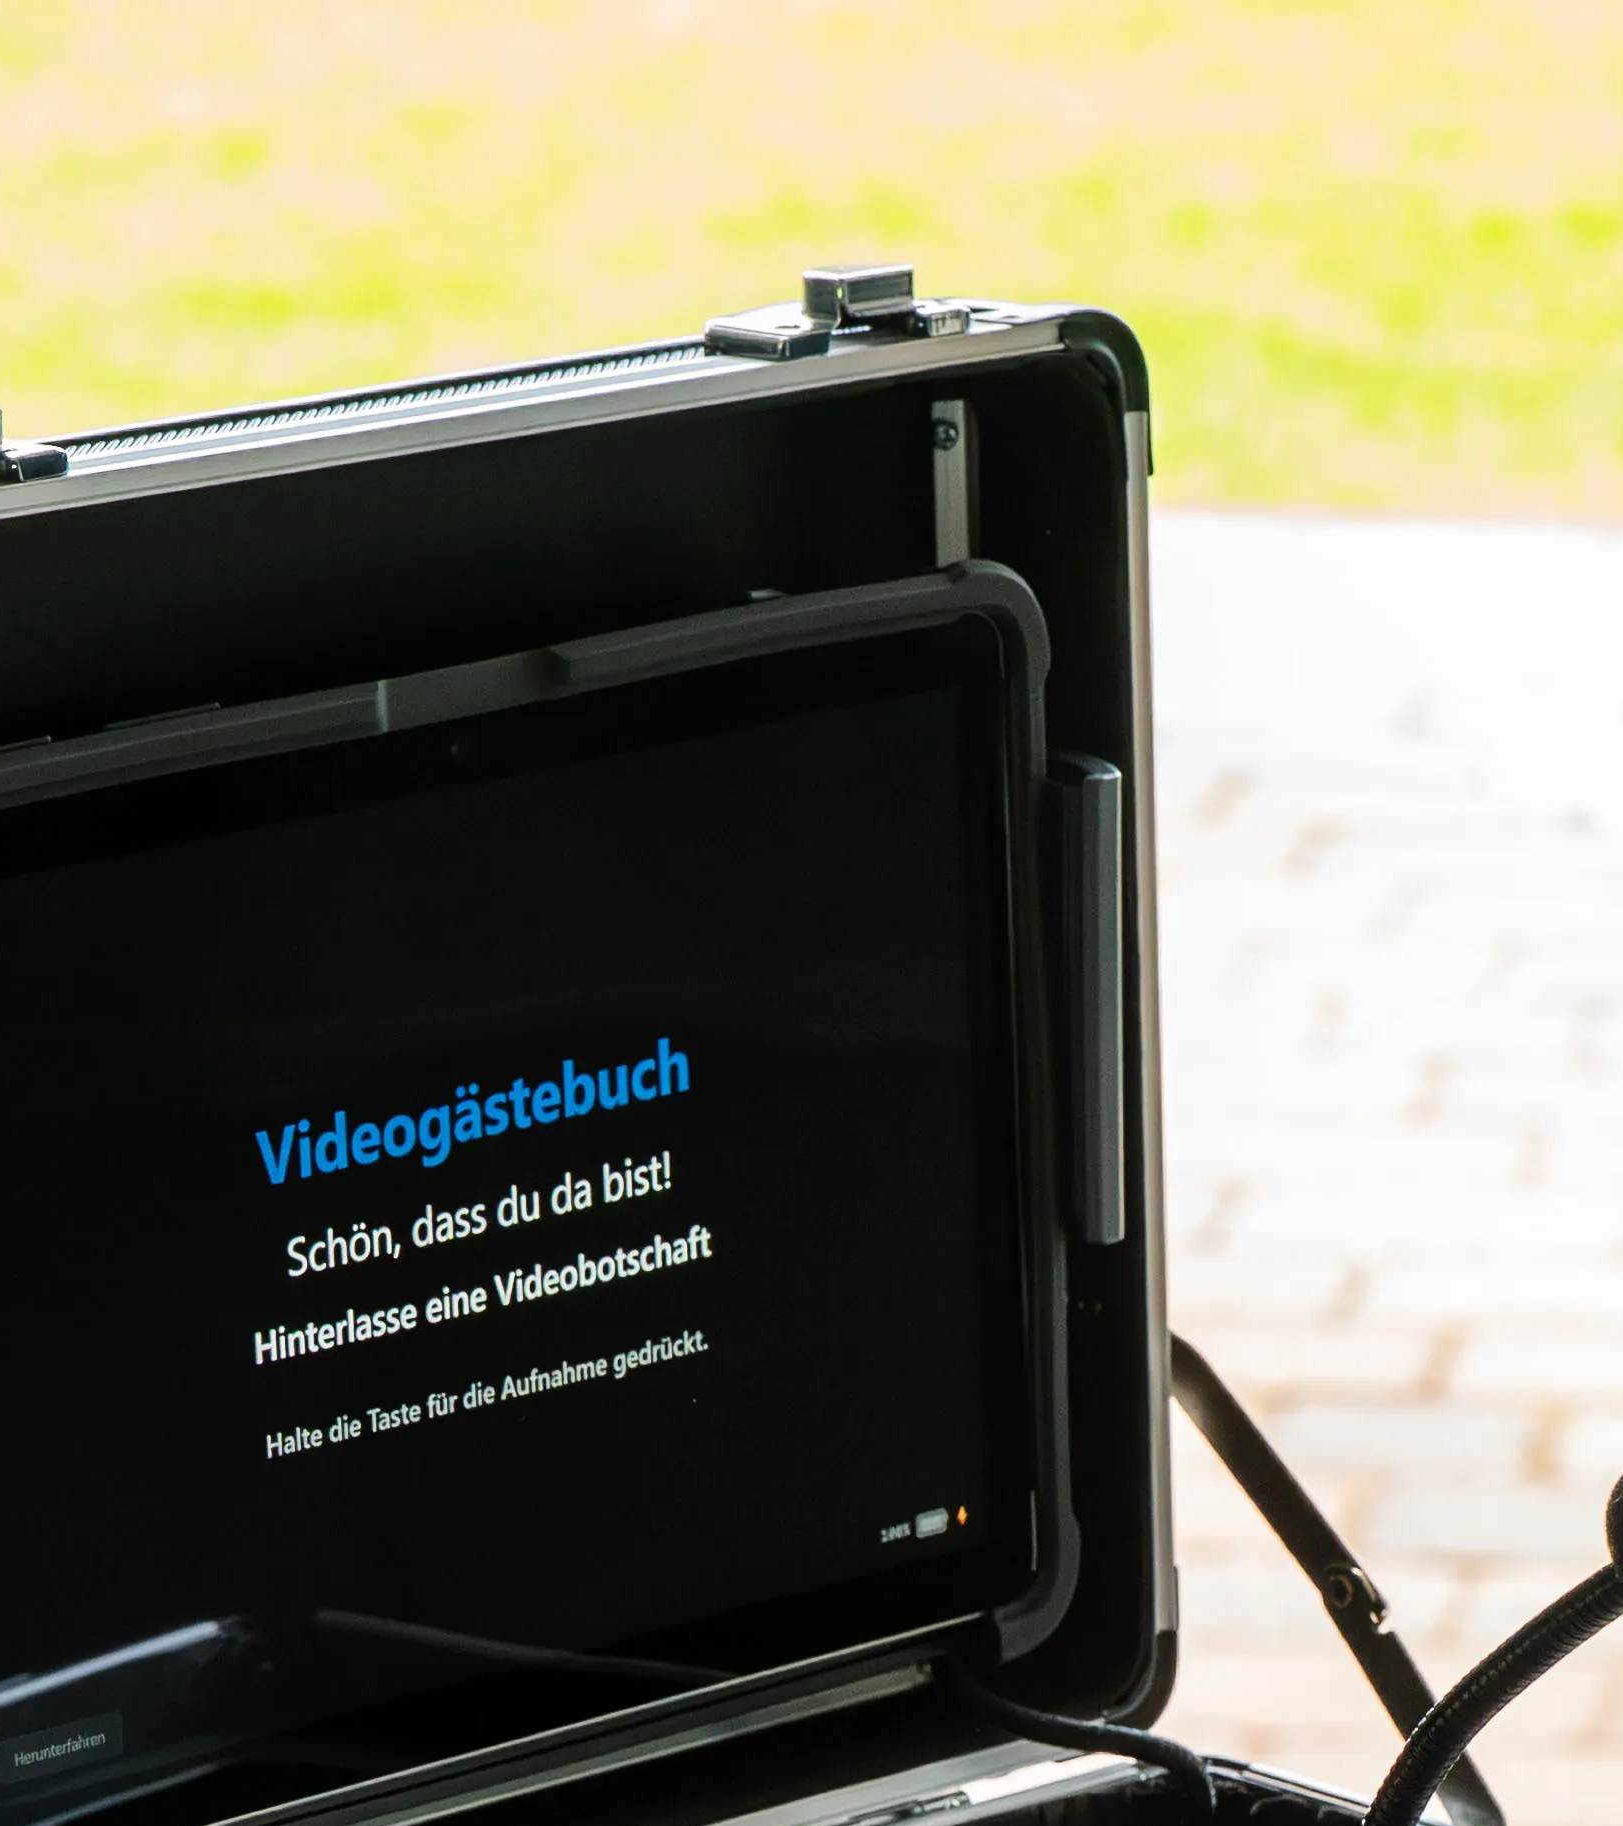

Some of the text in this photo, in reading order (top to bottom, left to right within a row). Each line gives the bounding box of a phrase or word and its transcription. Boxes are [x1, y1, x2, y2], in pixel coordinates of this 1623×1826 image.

[255, 1038, 689, 1184] Videogästebuch
[287, 1151, 671, 1277] Schön, dass du da bist!
[255, 1225, 712, 1365] Hinterlasse eine Videobotschaft
[266, 1330, 708, 1459] Halte die Taste für die Aufnahme gedrückt.
[14, 1733, 106, 1767] Herunterfahren
